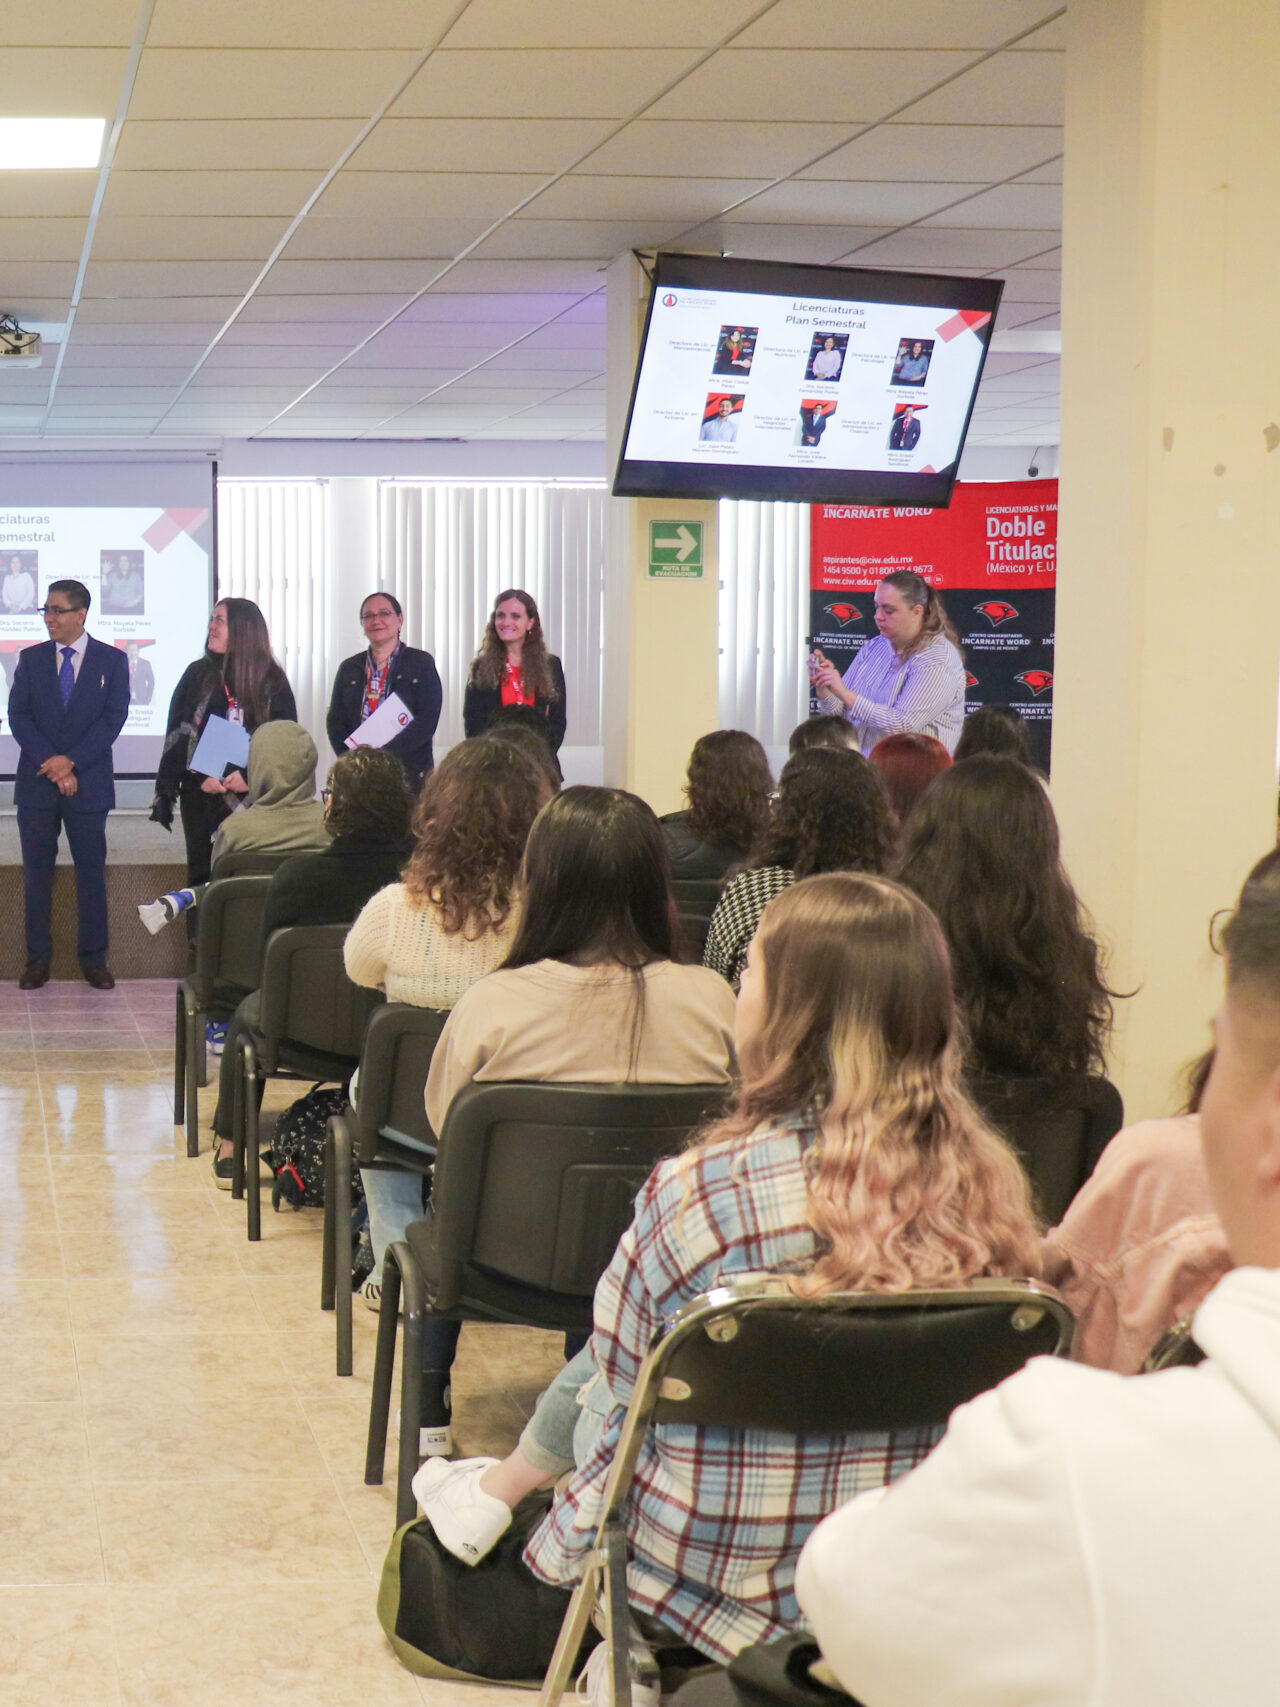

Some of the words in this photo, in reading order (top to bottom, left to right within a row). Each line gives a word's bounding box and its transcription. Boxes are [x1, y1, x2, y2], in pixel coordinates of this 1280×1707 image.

[792, 302, 865, 316] Licenciaturas
[785, 315, 810, 325] Plan
[811, 317, 867, 329] Semestral
[823, 508, 890, 519] INCARNATE
[893, 506, 933, 518] WORD
[985, 505, 1039, 514] LICENCIATURAS
[986, 515, 1046, 538] Doble
[823, 556, 913, 566] aspirantes@ciw.edu.mx
[823, 566, 840, 574] 1454
[841, 566, 861, 575] 9500
[862, 567, 868, 576] y
[986, 562, 1026, 576] (México
[1027, 564, 1034, 576] y
[823, 577, 881, 586] www.ciw.edu.m
[813, 637, 851, 645] INCARNATE
[961, 638, 1005, 646] INCARNATE
[1006, 638, 1031, 646] WORD
